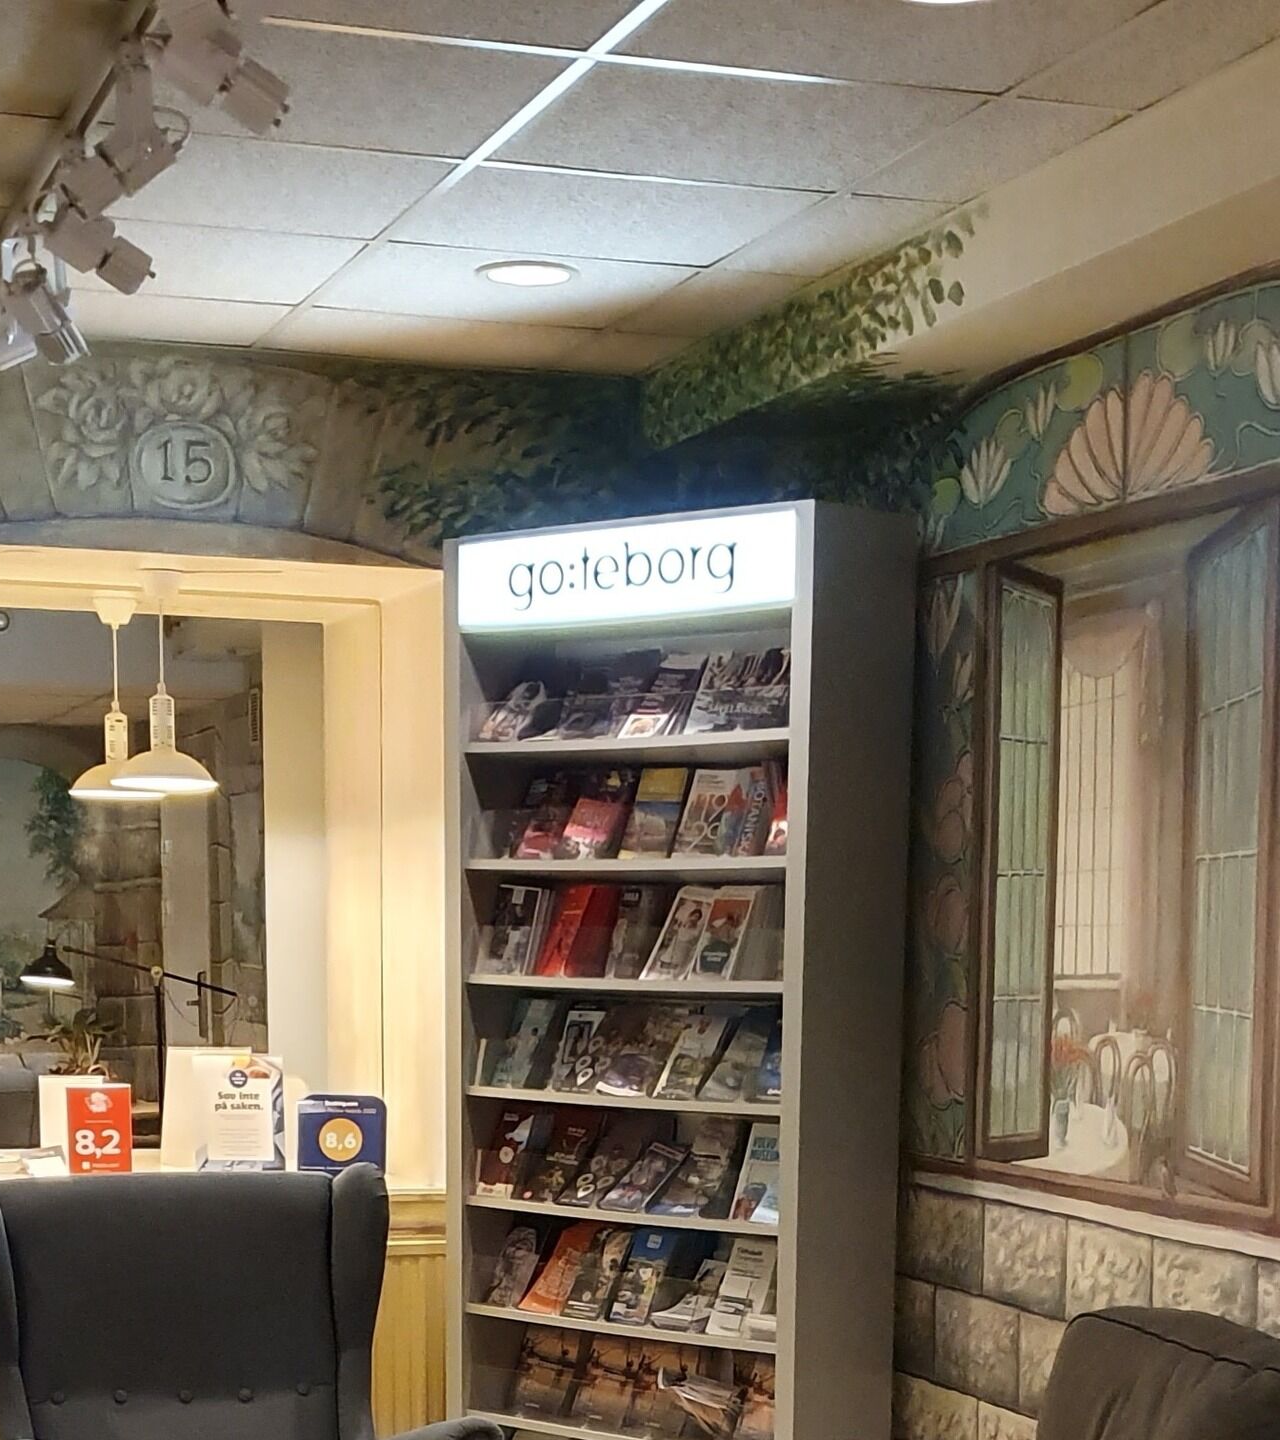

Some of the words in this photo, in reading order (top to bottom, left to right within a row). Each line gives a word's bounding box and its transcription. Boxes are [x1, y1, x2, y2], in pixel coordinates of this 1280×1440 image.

[157, 438, 216, 485] 15
[508, 541, 737, 611] go:teborg
[214, 1102, 228, 1112] på
[230, 1102, 264, 1111] saken.
[239, 1091, 260, 1100] inte
[75, 1129, 121, 1159] 8,2
[325, 1132, 357, 1151] 8,6
